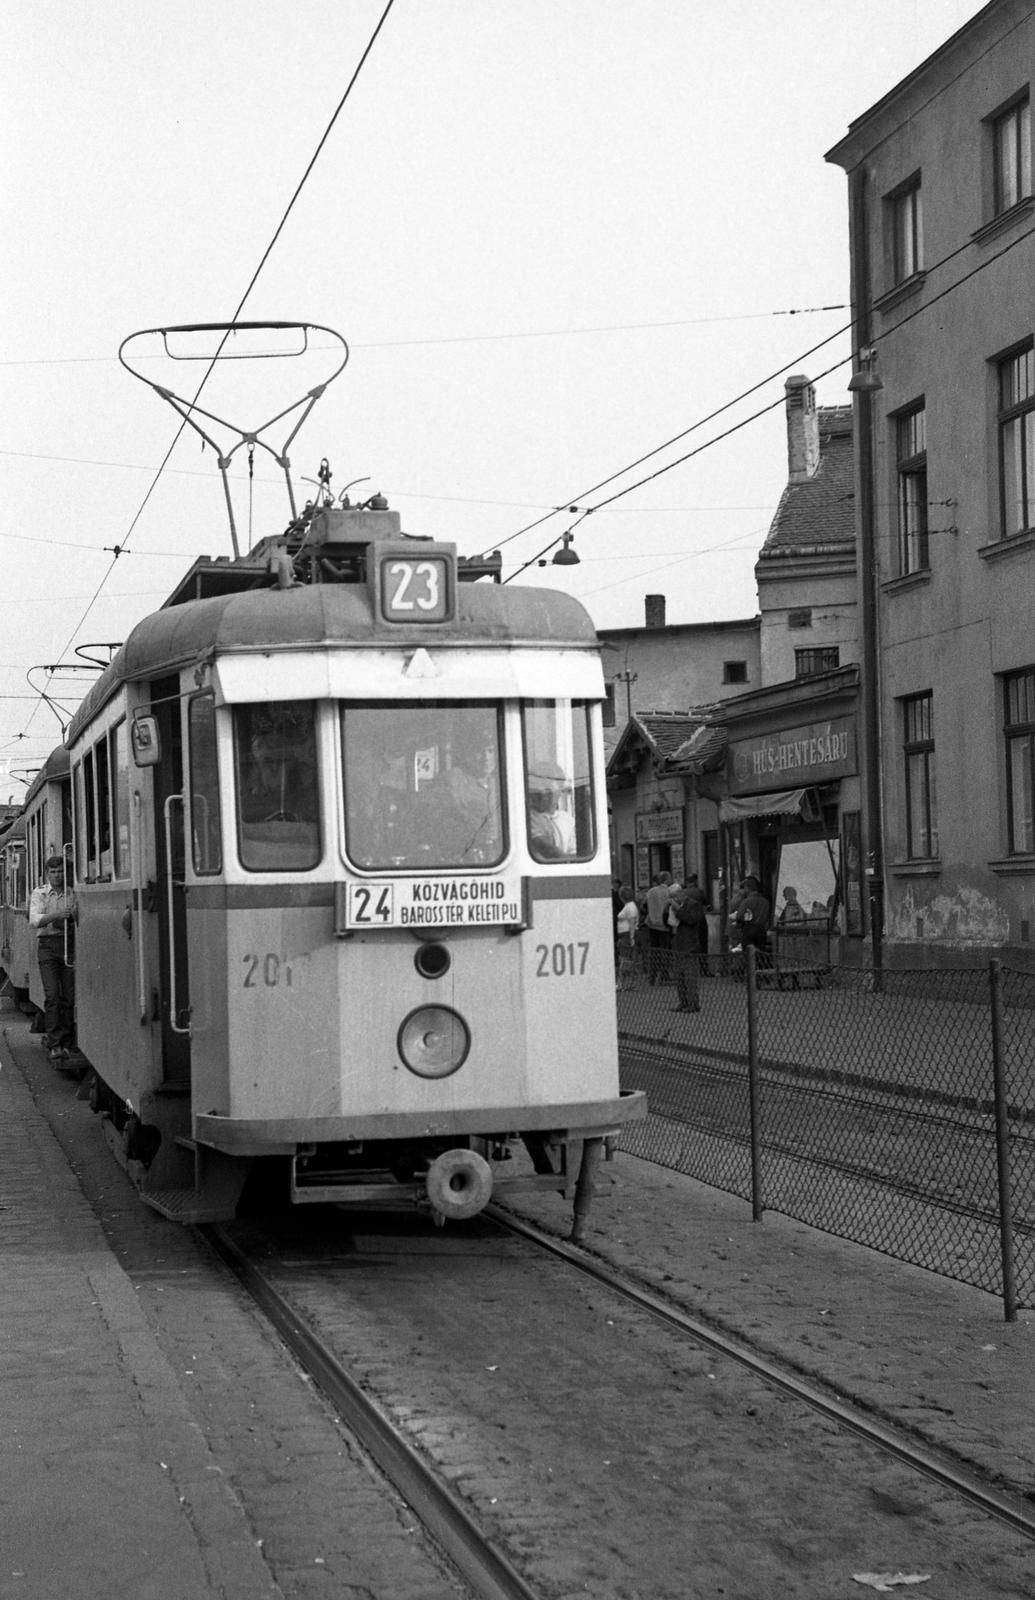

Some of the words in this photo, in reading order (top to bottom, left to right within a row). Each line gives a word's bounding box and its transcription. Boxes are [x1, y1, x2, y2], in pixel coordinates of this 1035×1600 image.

[391, 562, 438, 610] 23
[752, 723, 848, 774] HÚS-HENTESÁRU
[354, 887, 390, 922] 24
[401, 905, 444, 924] BAROSS
[445, 901, 464, 922] TÉR
[468, 903, 500, 921] KELETI
[536, 942, 590, 977] 2017
